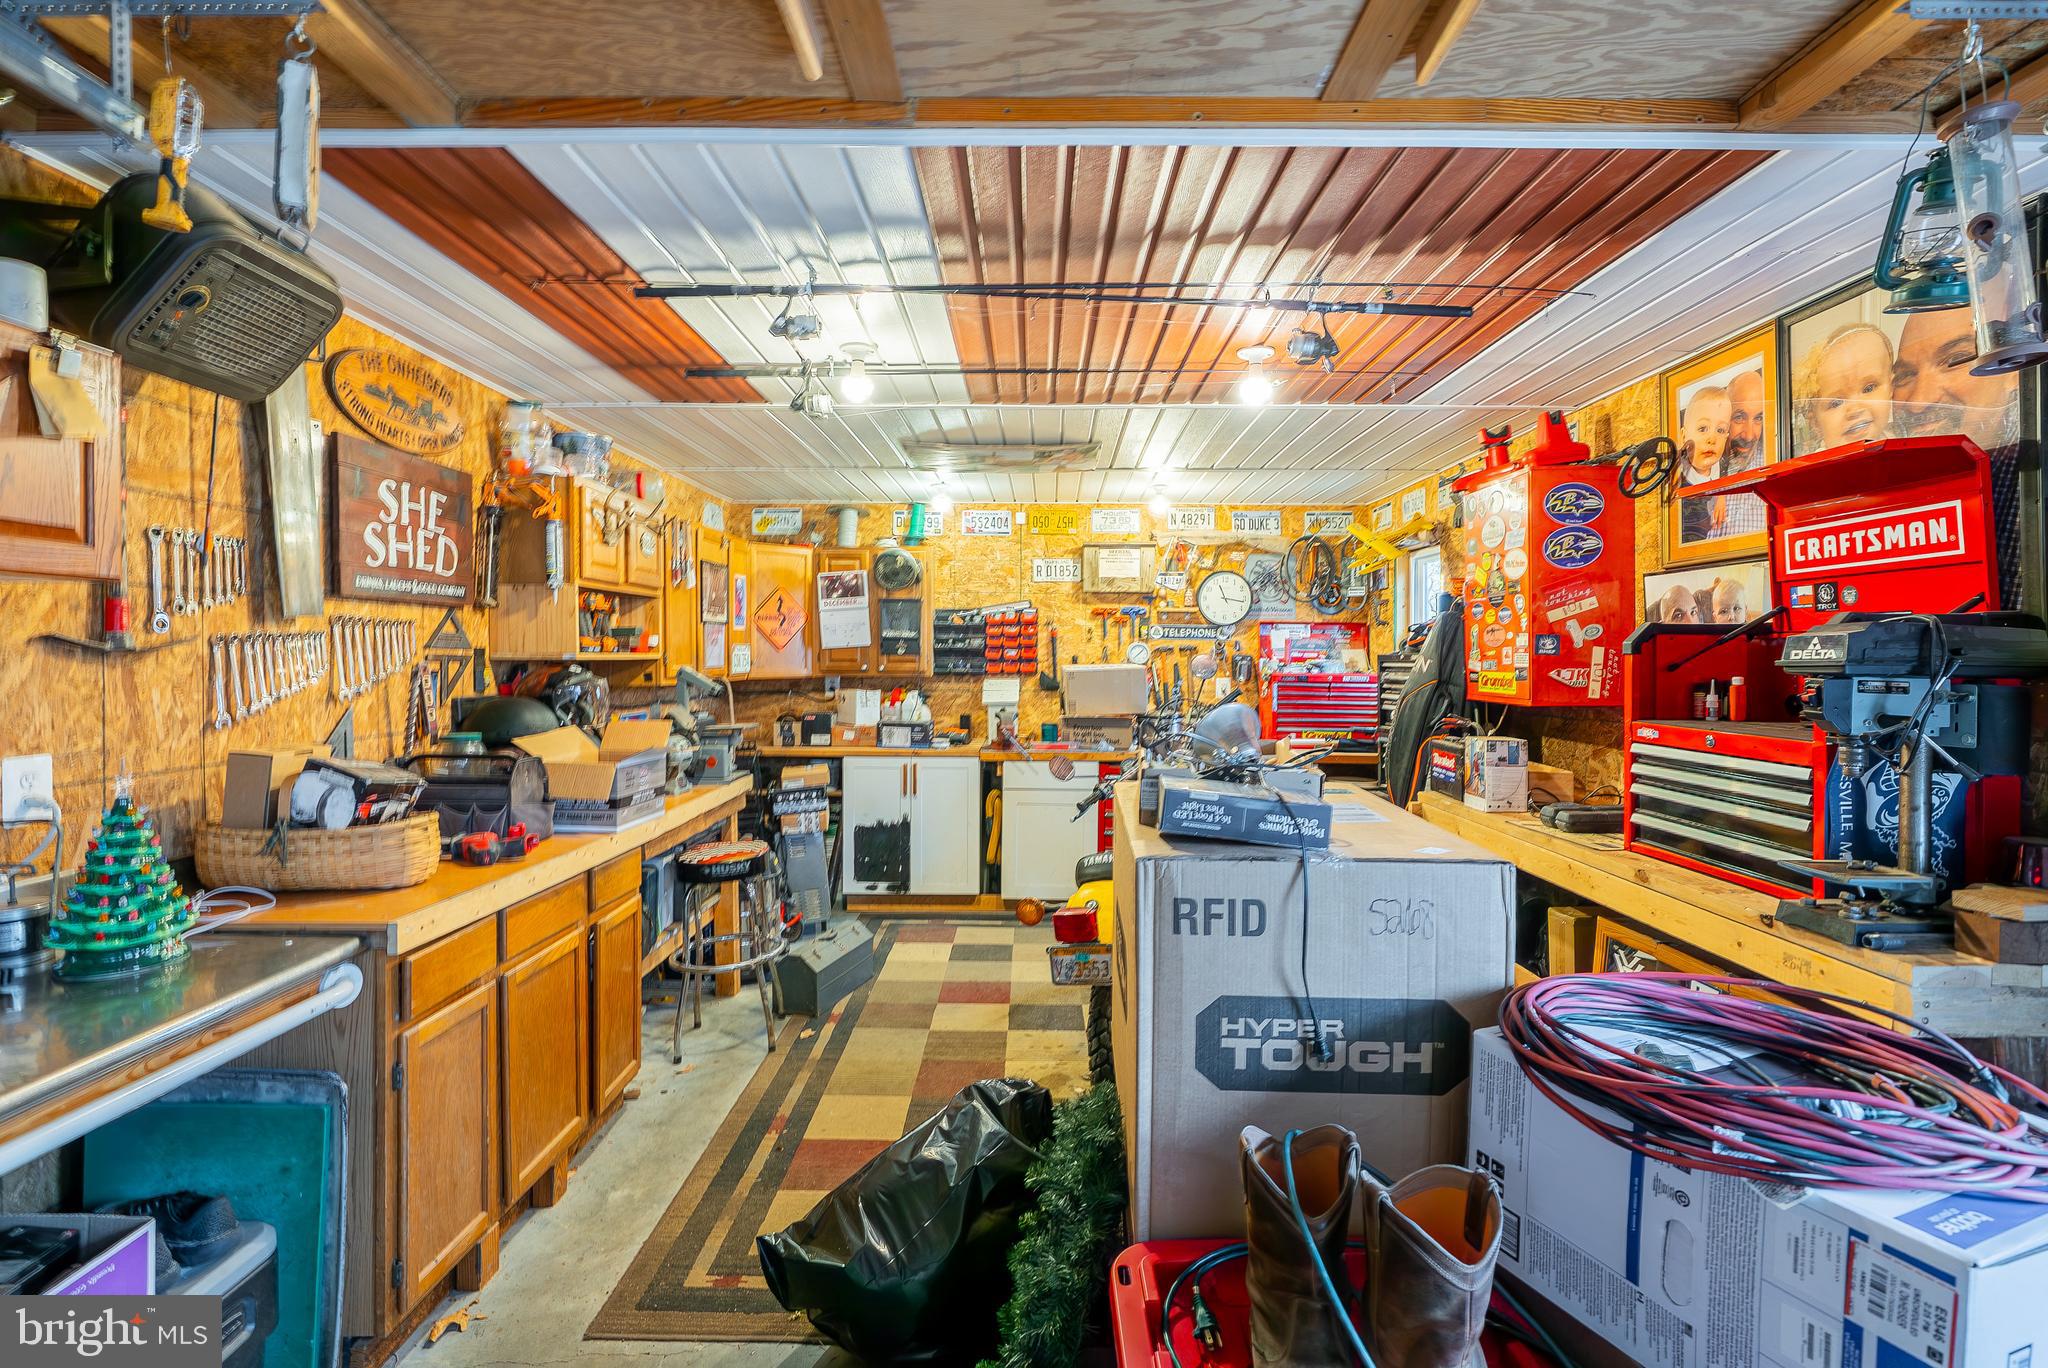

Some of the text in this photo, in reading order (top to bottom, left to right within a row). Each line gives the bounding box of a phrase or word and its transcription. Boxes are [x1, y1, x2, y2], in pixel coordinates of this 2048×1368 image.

[338, 379, 374, 426] STRONG
[375, 419, 411, 446] HEARTS
[377, 478, 448, 535] SHE
[1170, 513, 1212, 526] N 48291
[1248, 517, 1272, 531] DUKE
[1273, 516, 1280, 530] 3
[1794, 517, 1948, 562] CRAFTSMAN
[363, 521, 459, 578] SHED
[1036, 564, 1043, 578] R
[1817, 602, 1837, 611] TROY
[1163, 627, 1219, 638] TELEPHONE
[1790, 649, 1837, 660] DELTA
[1258, 821, 1300, 836] Homes
[711, 862, 751, 876] HUSKY
[1172, 896, 1268, 938] RFID
[1220, 1016, 1346, 1039] HYPER
[1220, 1037, 1434, 1075] TOUGH
[1932, 1304, 1949, 1344] E8346
